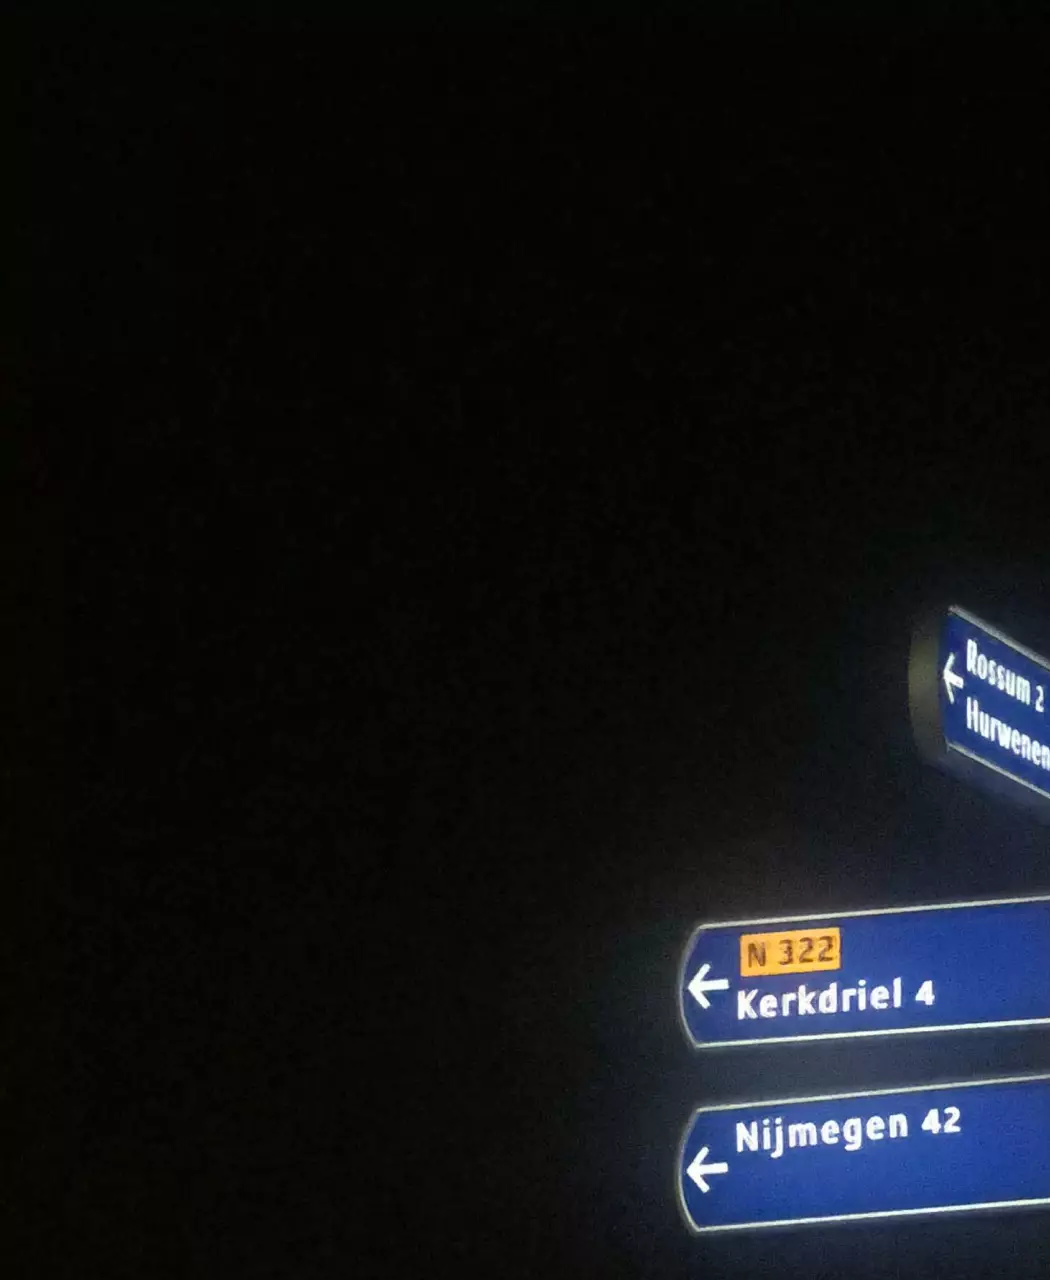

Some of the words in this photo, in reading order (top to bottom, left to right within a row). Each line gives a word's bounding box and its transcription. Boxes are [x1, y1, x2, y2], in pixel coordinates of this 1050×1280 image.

[966, 638, 1031, 705] Rossum
[1035, 685, 1045, 713] 2
[746, 943, 766, 968] N
[778, 935, 835, 965] 322
[736, 977, 902, 1020] Kerkdriel
[915, 980, 936, 1006] 4
[734, 1111, 908, 1159] Nijmegen
[921, 1106, 962, 1134] 42
